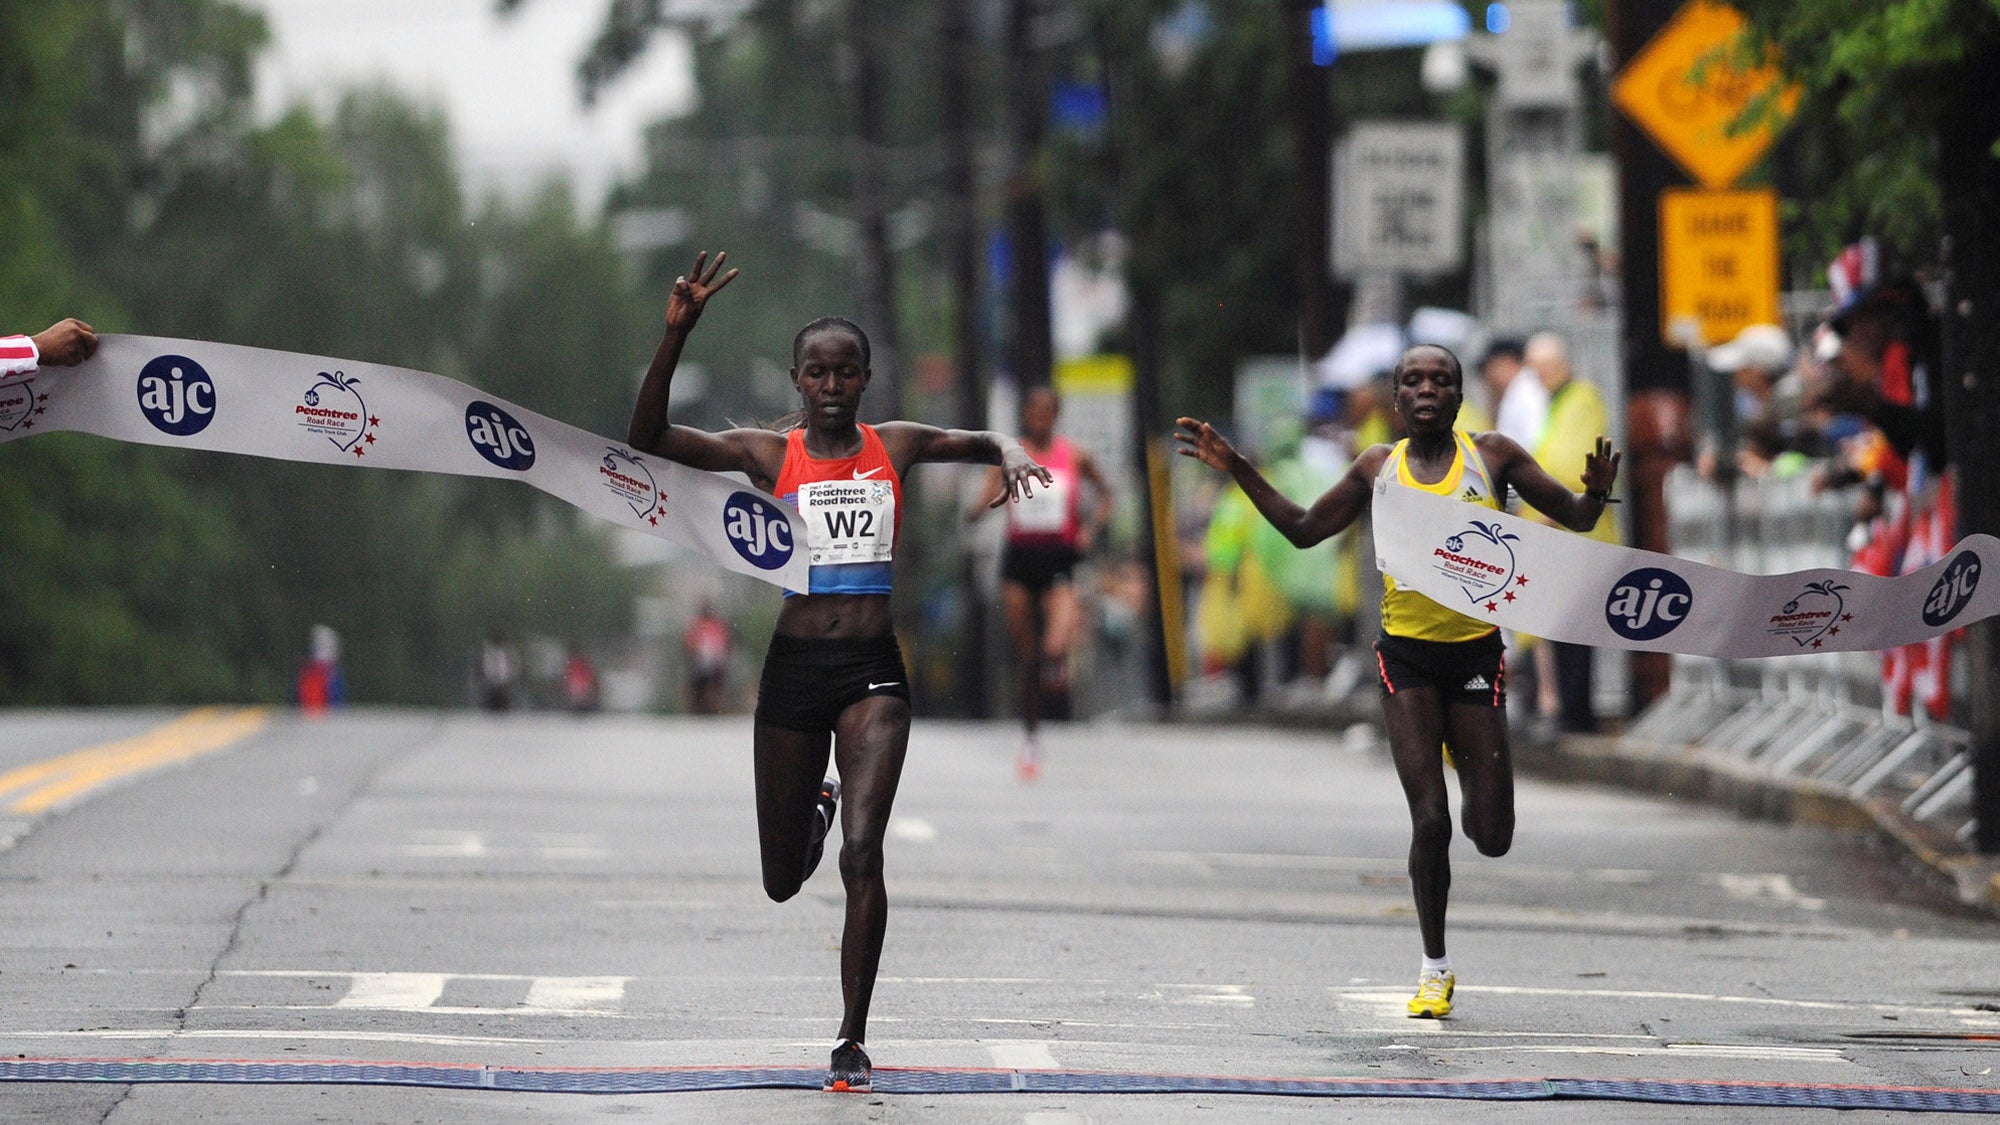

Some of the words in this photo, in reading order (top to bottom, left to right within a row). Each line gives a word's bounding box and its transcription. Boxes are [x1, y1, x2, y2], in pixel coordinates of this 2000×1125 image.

[141, 367, 212, 424] ajc
[295, 405, 358, 420] Peachtree
[306, 416, 325, 425] Road
[326, 418, 345, 427] Race
[469, 412, 532, 459] ajc
[600, 466, 650, 491] Peachtree
[610, 478, 625, 489] Road
[626, 485, 641, 495] Race
[809, 488, 866, 497] Peachtree
[809, 497, 838, 506] Road
[839, 496, 867, 504] Race
[727, 502, 791, 556] ajc
[824, 510, 875, 539] W2
[1446, 538, 1463, 550] ajc
[1434, 548, 1505, 575] Peachtree
[1444, 561, 1465, 573] Road
[1466, 568, 1487, 579] Race
[1925, 564, 1978, 617] ajc
[1609, 578, 1689, 629] ajc
[1770, 611, 1831, 622] Peachtree
